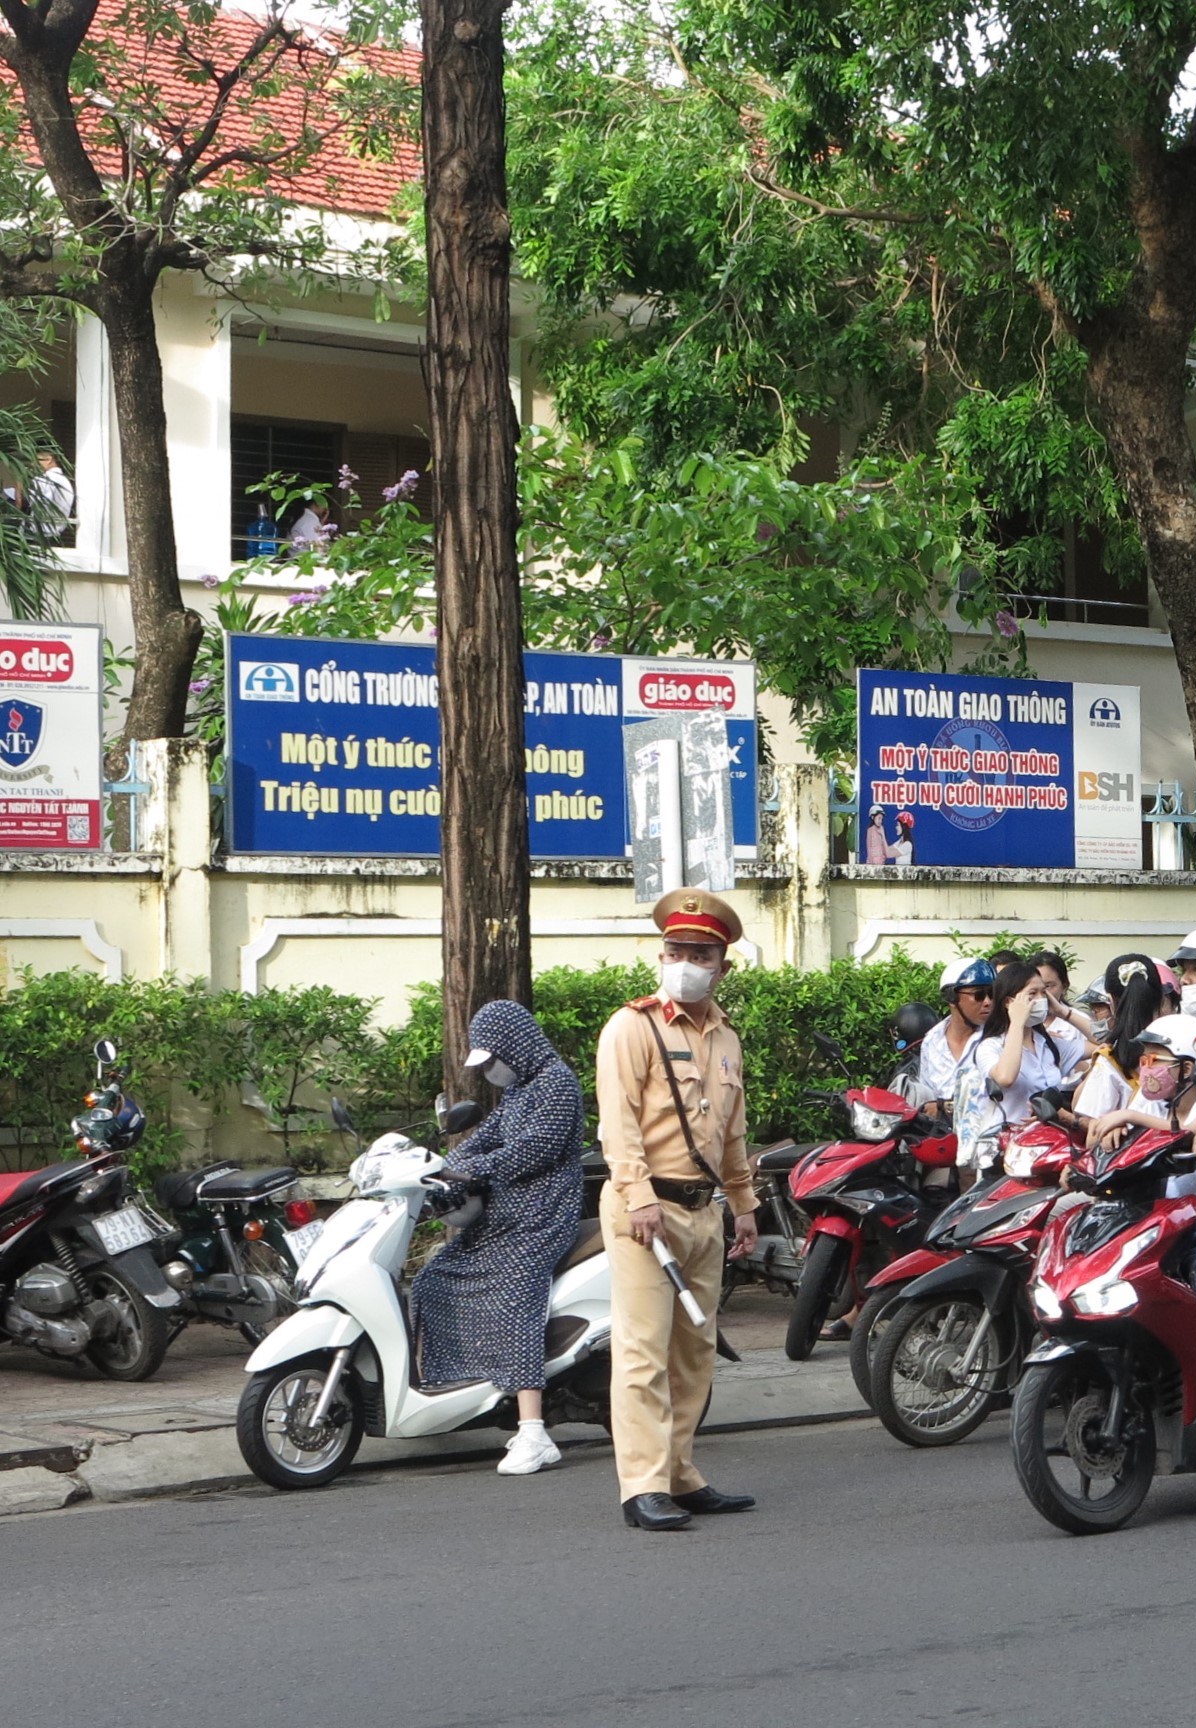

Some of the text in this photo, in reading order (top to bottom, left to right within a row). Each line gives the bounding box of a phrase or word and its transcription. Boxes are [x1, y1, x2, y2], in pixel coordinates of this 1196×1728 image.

[21, 647, 70, 678] dục
[305, 660, 360, 704] CỔNG
[363, 668, 439, 708] TRƯỜNG
[543, 682, 568, 714] AN
[570, 678, 618, 716] TOÀN
[644, 677, 732, 706] giáo dục
[870, 684, 1067, 725] AN TOÀN GIAO THÔNG
[281, 732, 338, 772] Một
[342, 735, 359, 769] ý
[366, 736, 431, 769] thức
[880, 743, 1059, 776] MỘT Ý THỨC GIAO THÔNG
[260, 780, 603, 822] Triệu nụ cườ phúc
[872, 778, 1067, 812] TRIỆU NỤ CƯỜI HẠNH PHÚC
[1078, 771, 1134, 802] BSH
